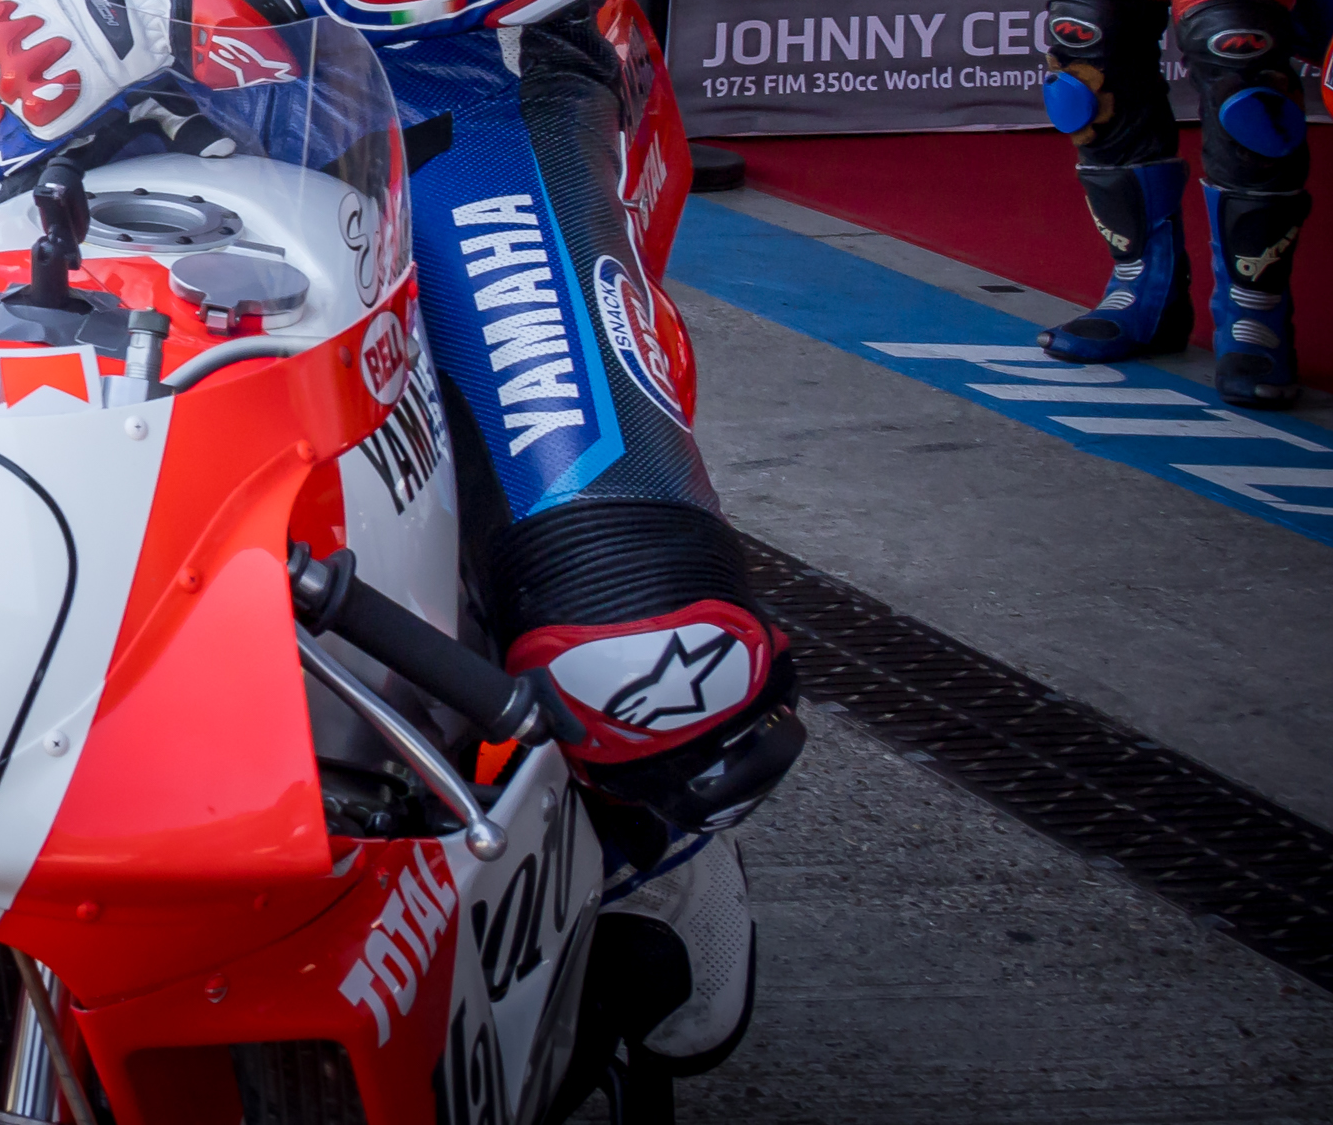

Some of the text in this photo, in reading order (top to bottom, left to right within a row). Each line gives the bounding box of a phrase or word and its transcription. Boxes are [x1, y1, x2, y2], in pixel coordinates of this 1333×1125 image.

[703, 12, 946, 68] JOHNNY
[701, 75, 759, 100] 1975
[763, 73, 809, 95] FIM
[813, 69, 879, 94] 350cc
[884, 65, 953, 91] World
[451, 193, 586, 457] YAMAHA
[600, 281, 632, 350] SNACK
[364, 316, 405, 395] BELL
[339, 841, 459, 1049] TOTAL
